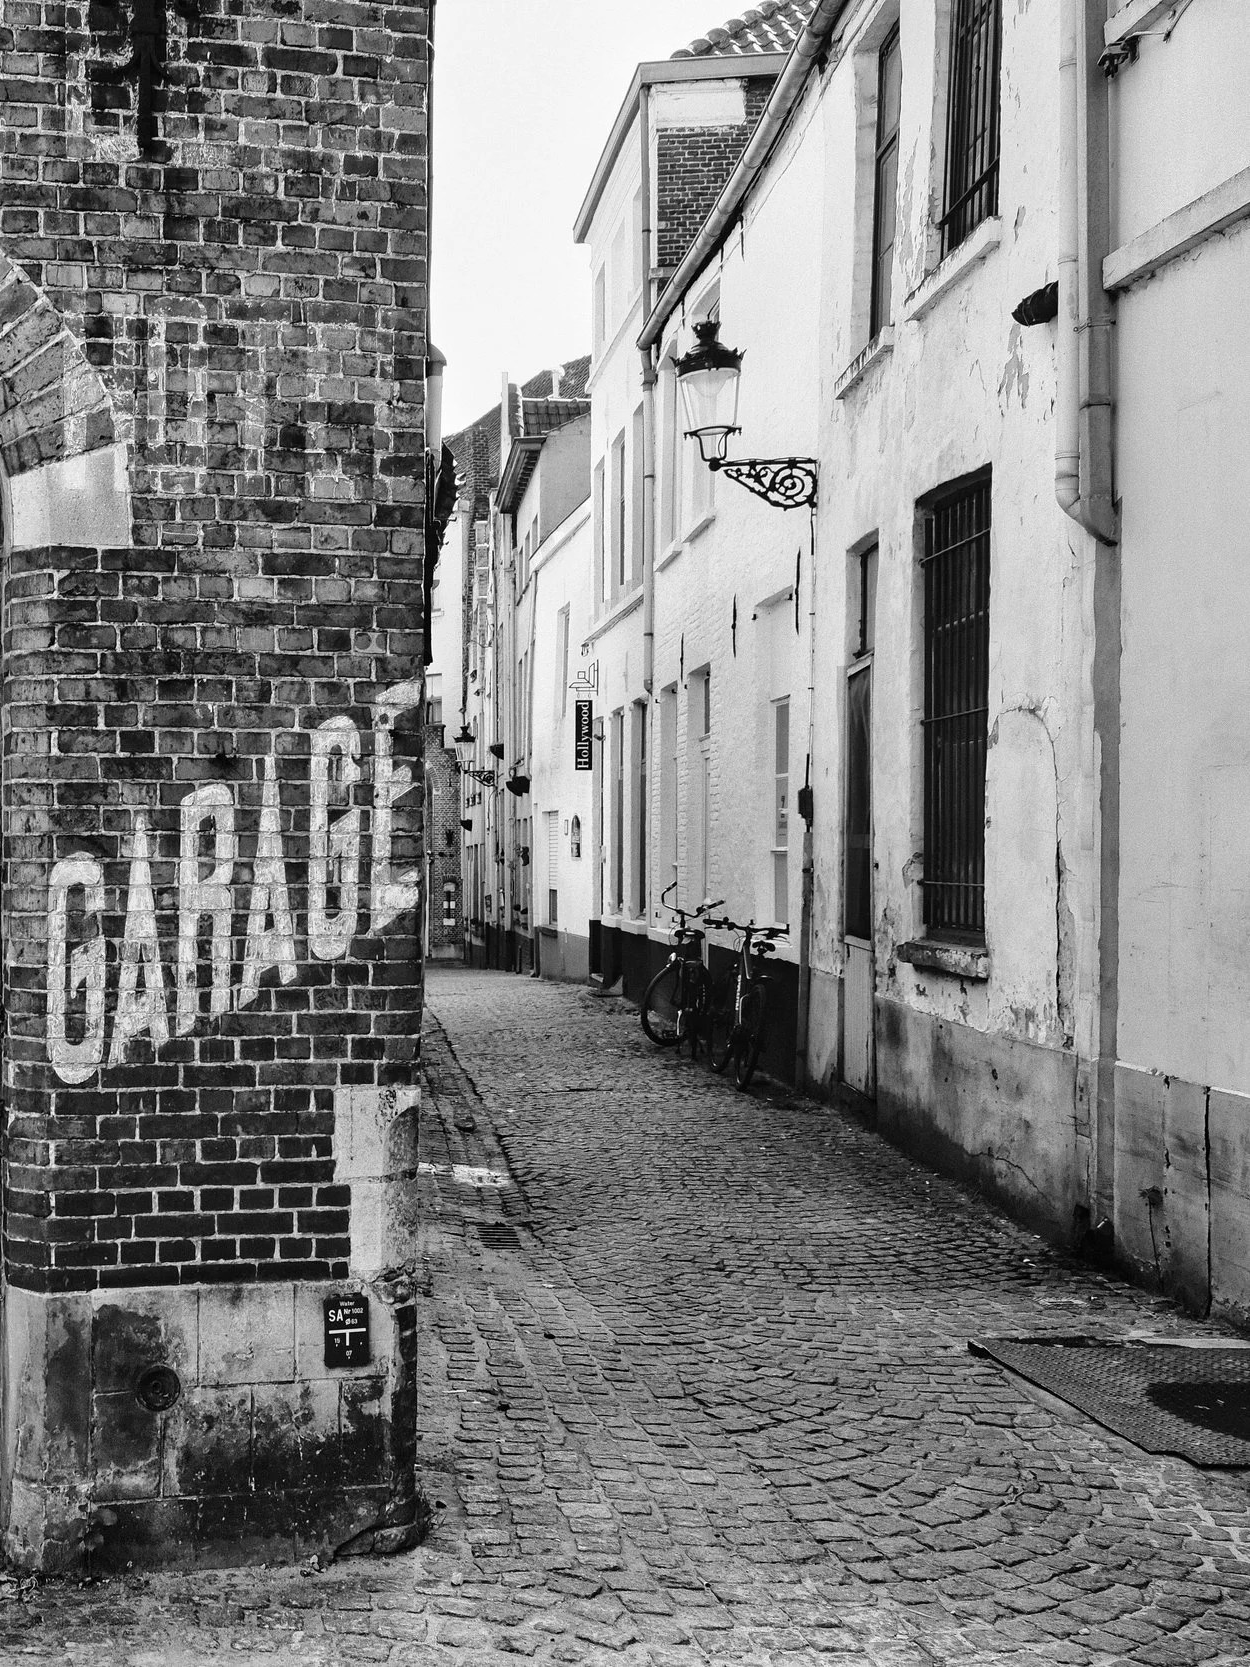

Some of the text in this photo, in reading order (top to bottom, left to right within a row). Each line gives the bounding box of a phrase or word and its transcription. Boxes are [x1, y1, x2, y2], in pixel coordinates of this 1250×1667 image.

[577, 701, 592, 769] Hollywood
[50, 680, 421, 1084] GARAGE
[328, 1309, 343, 1322] SA
